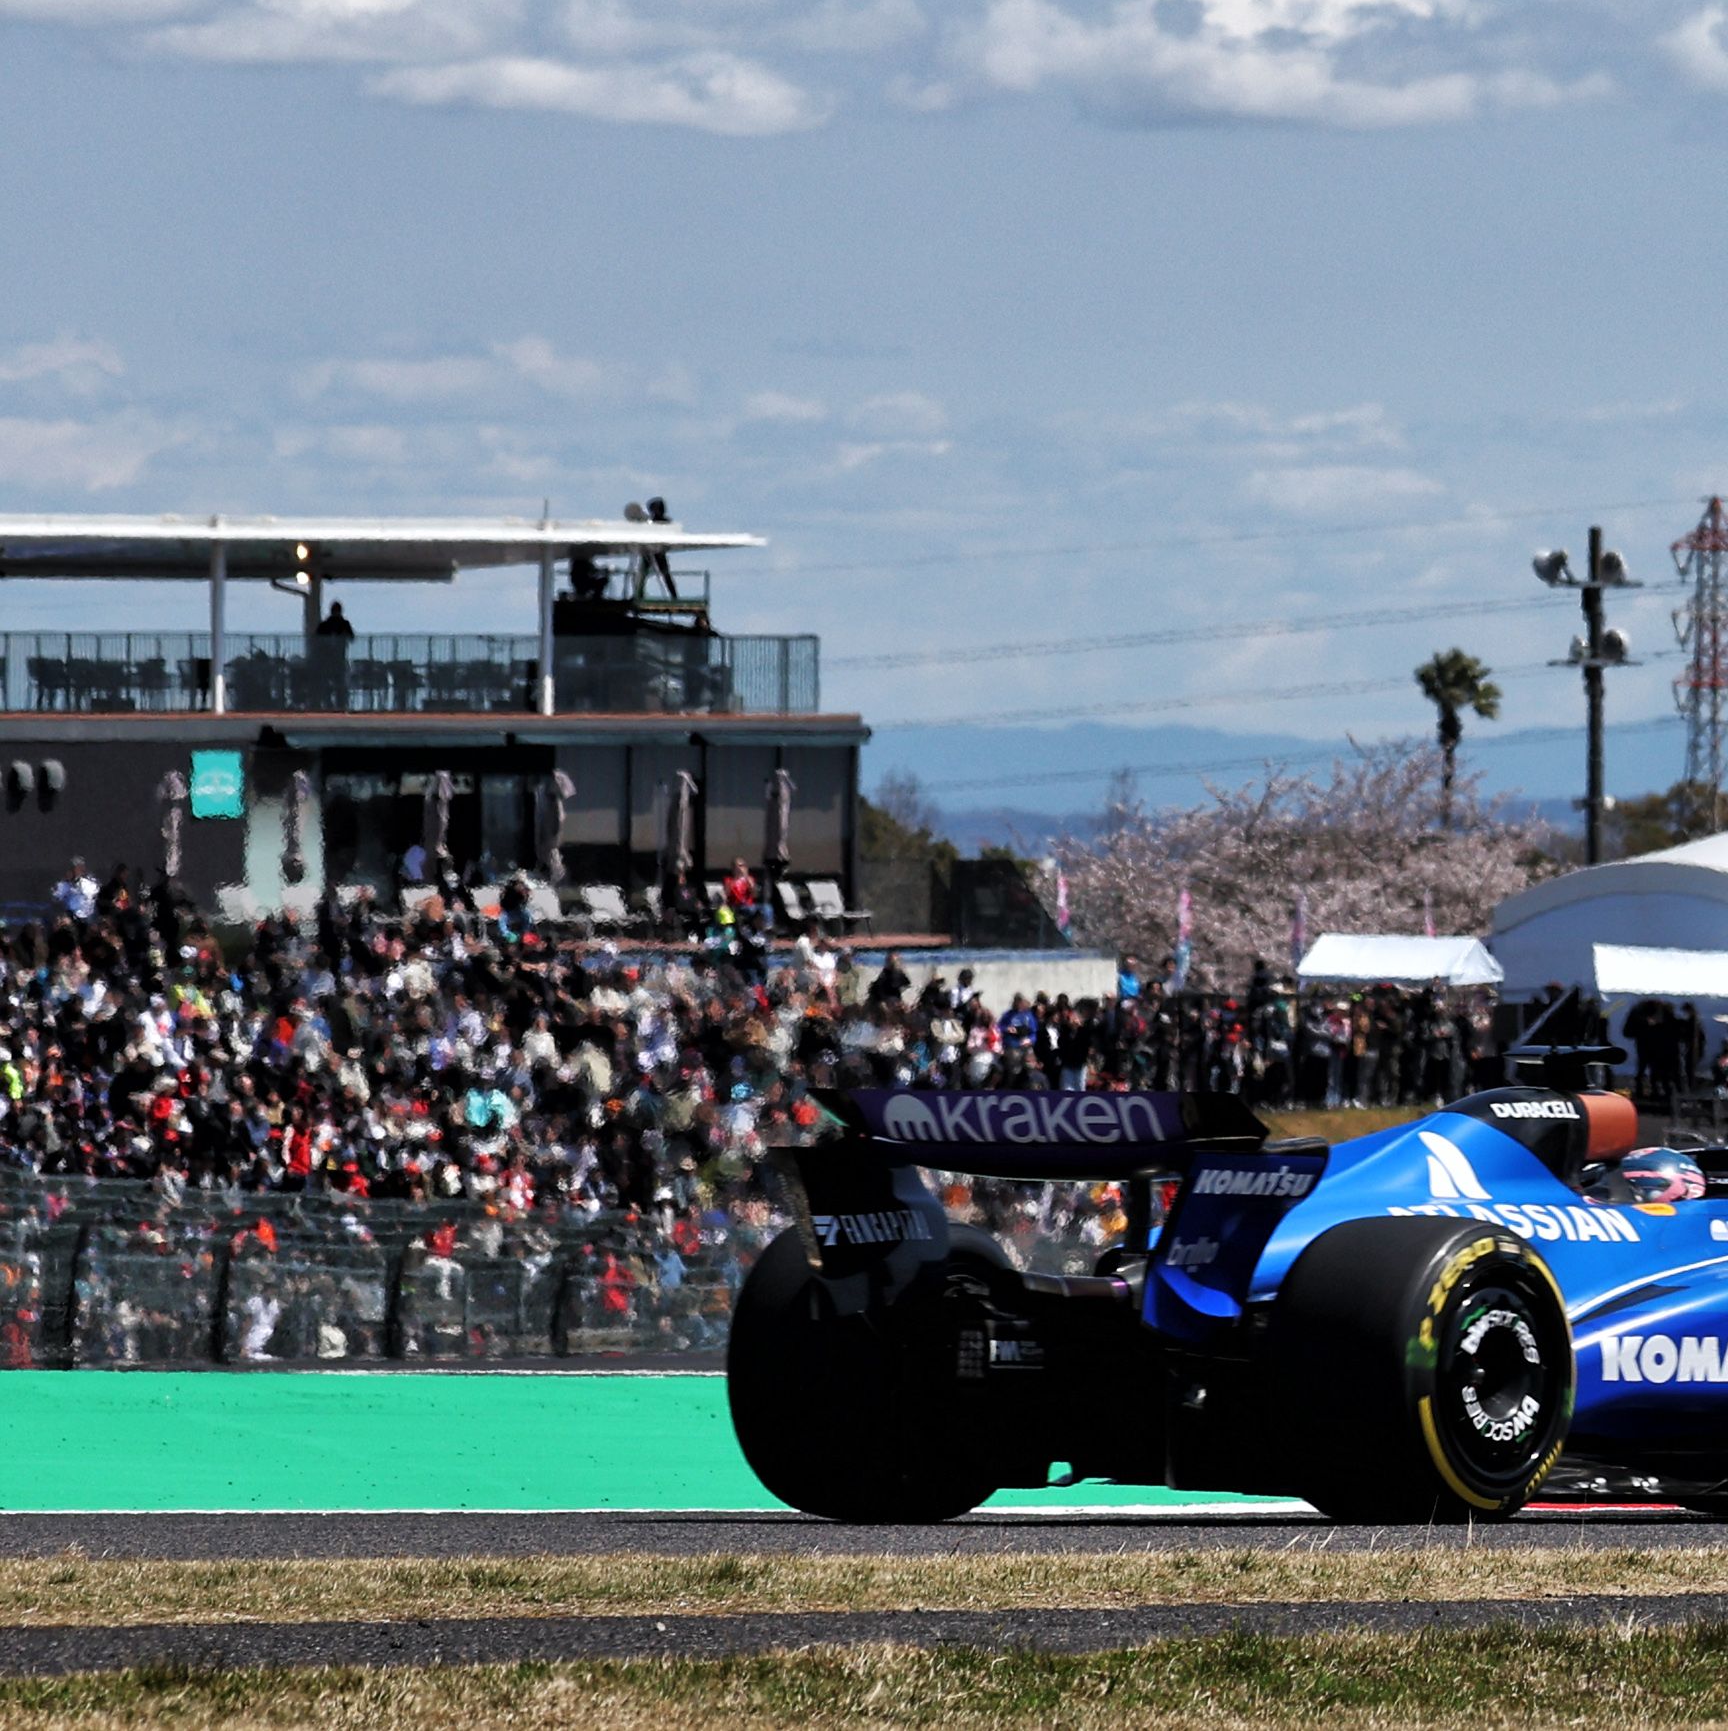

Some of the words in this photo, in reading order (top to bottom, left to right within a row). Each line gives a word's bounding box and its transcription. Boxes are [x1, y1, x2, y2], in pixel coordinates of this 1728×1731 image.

[936, 1094, 1166, 1143] kraken
[1489, 1100, 1581, 1119] DURACELL
[1192, 1165, 1315, 1197] KOMATSU
[1387, 1204, 1641, 1242] ASSIAN
[1426, 1237, 1495, 1316] ZERO
